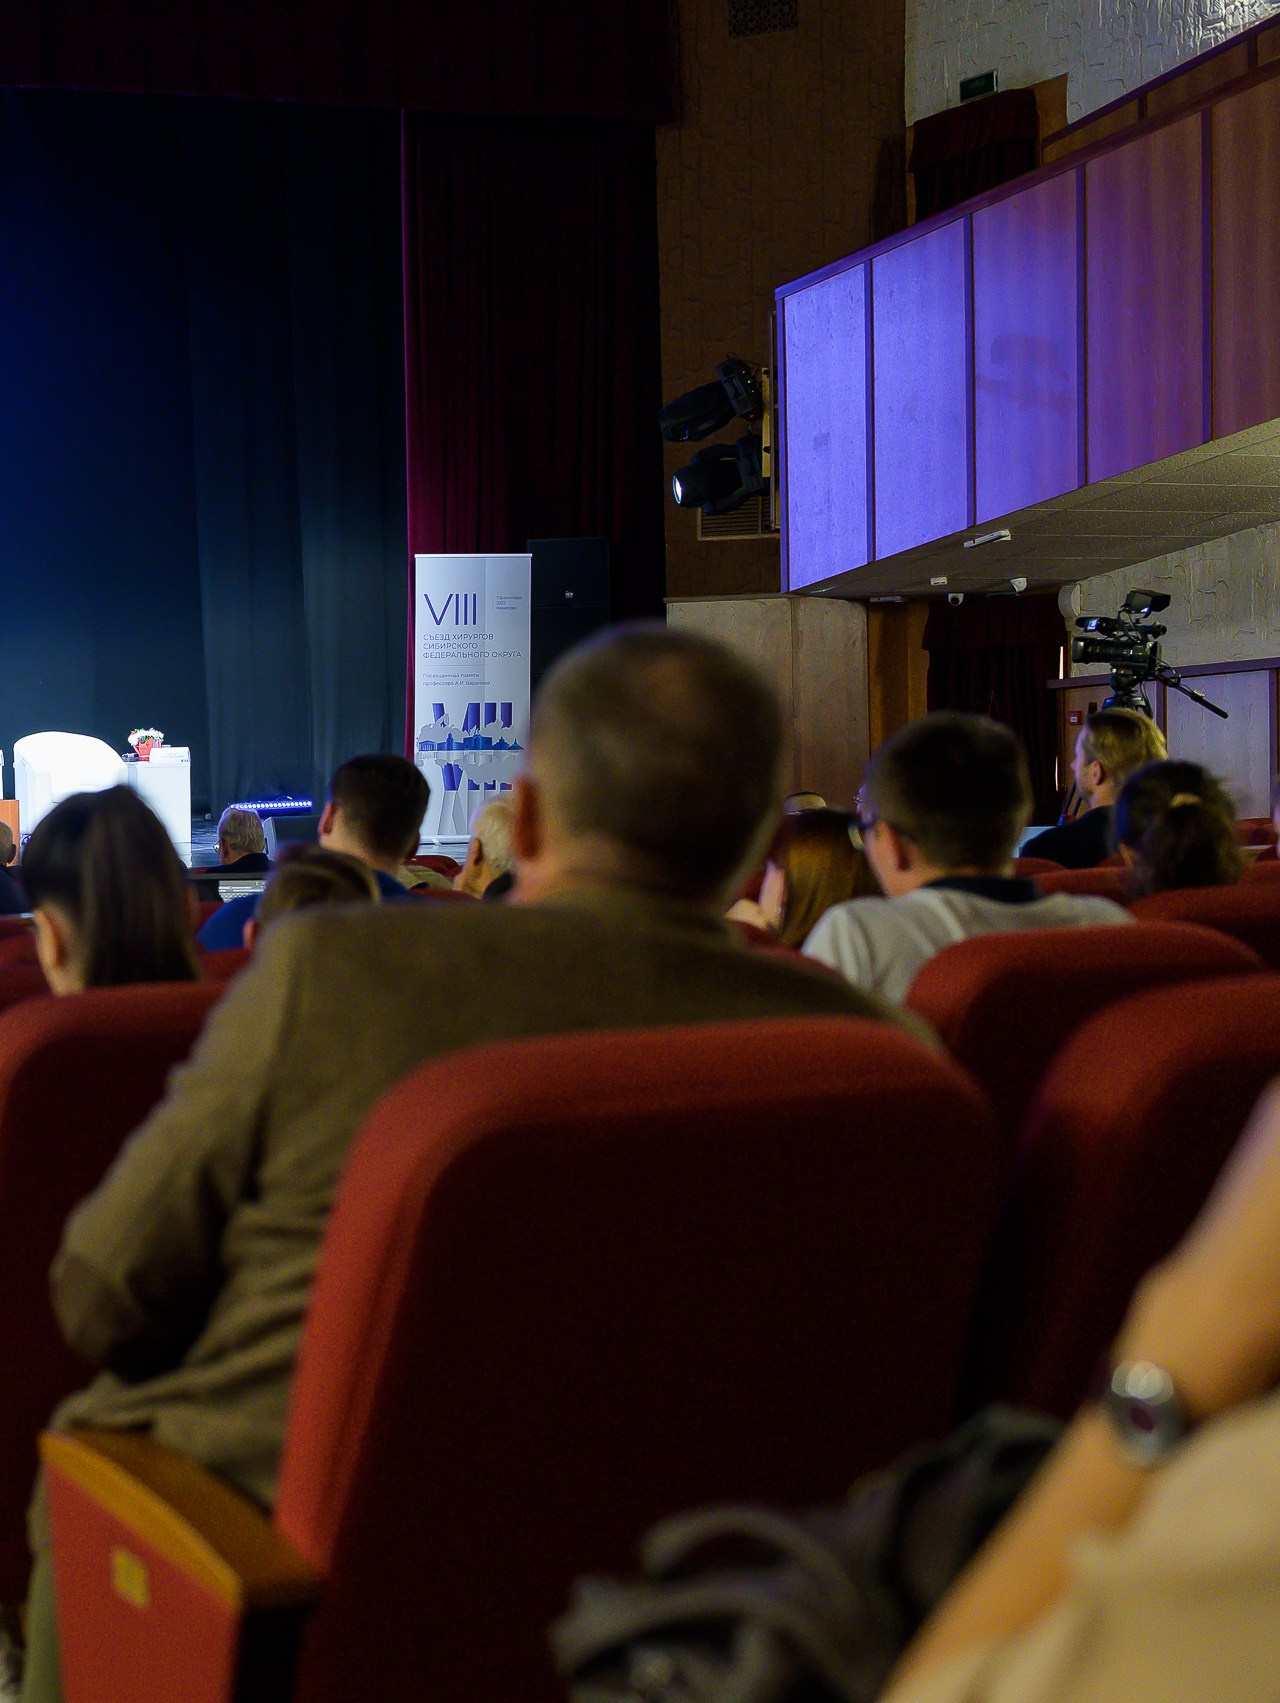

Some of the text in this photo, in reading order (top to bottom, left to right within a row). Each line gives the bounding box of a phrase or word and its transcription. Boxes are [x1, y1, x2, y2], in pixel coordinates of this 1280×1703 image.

[423, 593, 477, 626] VIII
[423, 633, 494, 641] СЪЕЗД ХИРУРГОВ
[423, 642, 478, 650] СИБИРСКОГО
[422, 650, 522, 659] ФЕДЕРАЛЬНОГО ОКРУГА
